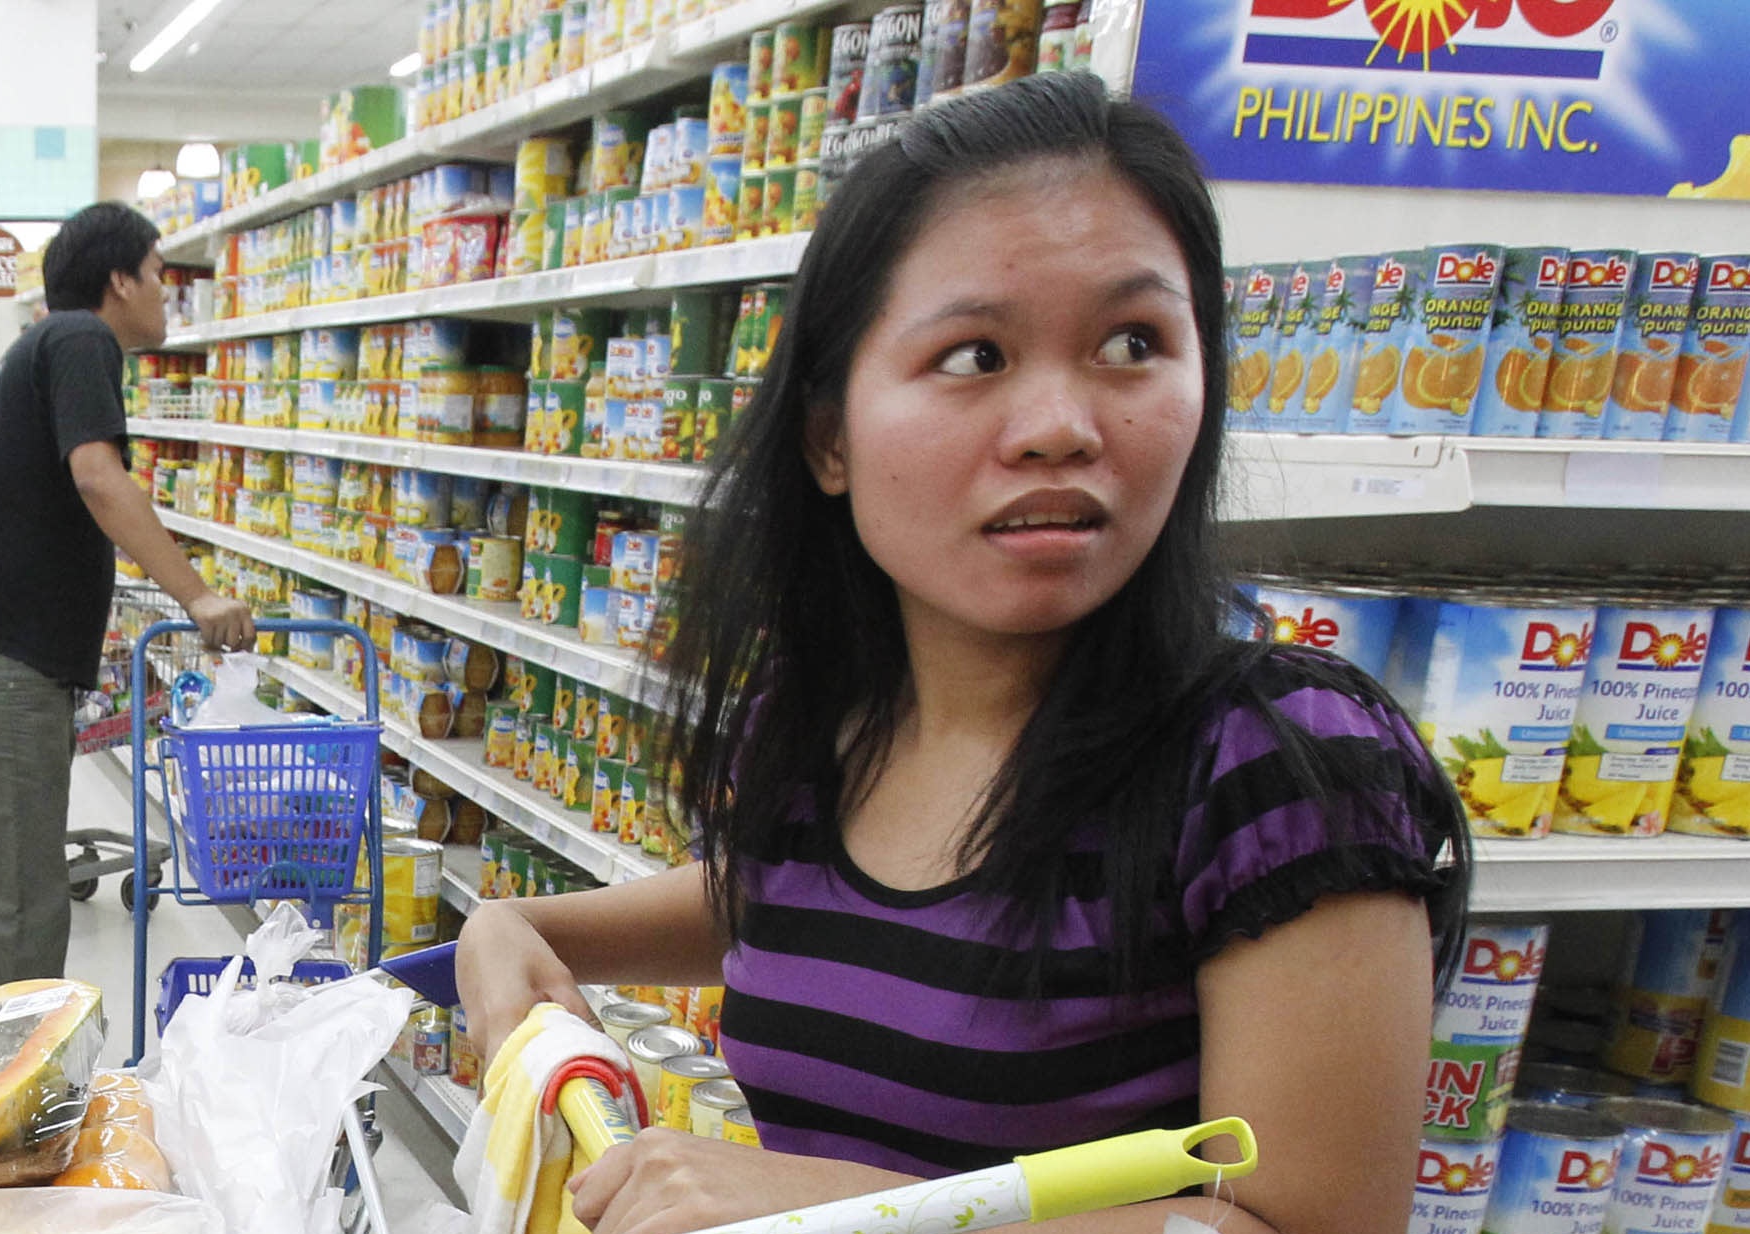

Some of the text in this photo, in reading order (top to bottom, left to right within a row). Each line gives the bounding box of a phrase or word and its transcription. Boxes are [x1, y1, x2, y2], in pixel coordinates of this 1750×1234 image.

[1231, 85, 1601, 153] PHILIPPINES INC.
[1437, 253, 1495, 282] Dole
[1570, 257, 1627, 286] Dole
[1425, 298, 1492, 316] ORANGE
[1493, 680, 1539, 700] 100%
[1592, 679, 1638, 700] 100%
[1635, 703, 1680, 721] Juice
[1478, 1015, 1519, 1032] Juice
[1415, 1149, 1494, 1194] Dole
[1531, 1199, 1575, 1217] 100%
[1650, 1213, 1695, 1230] Juice
